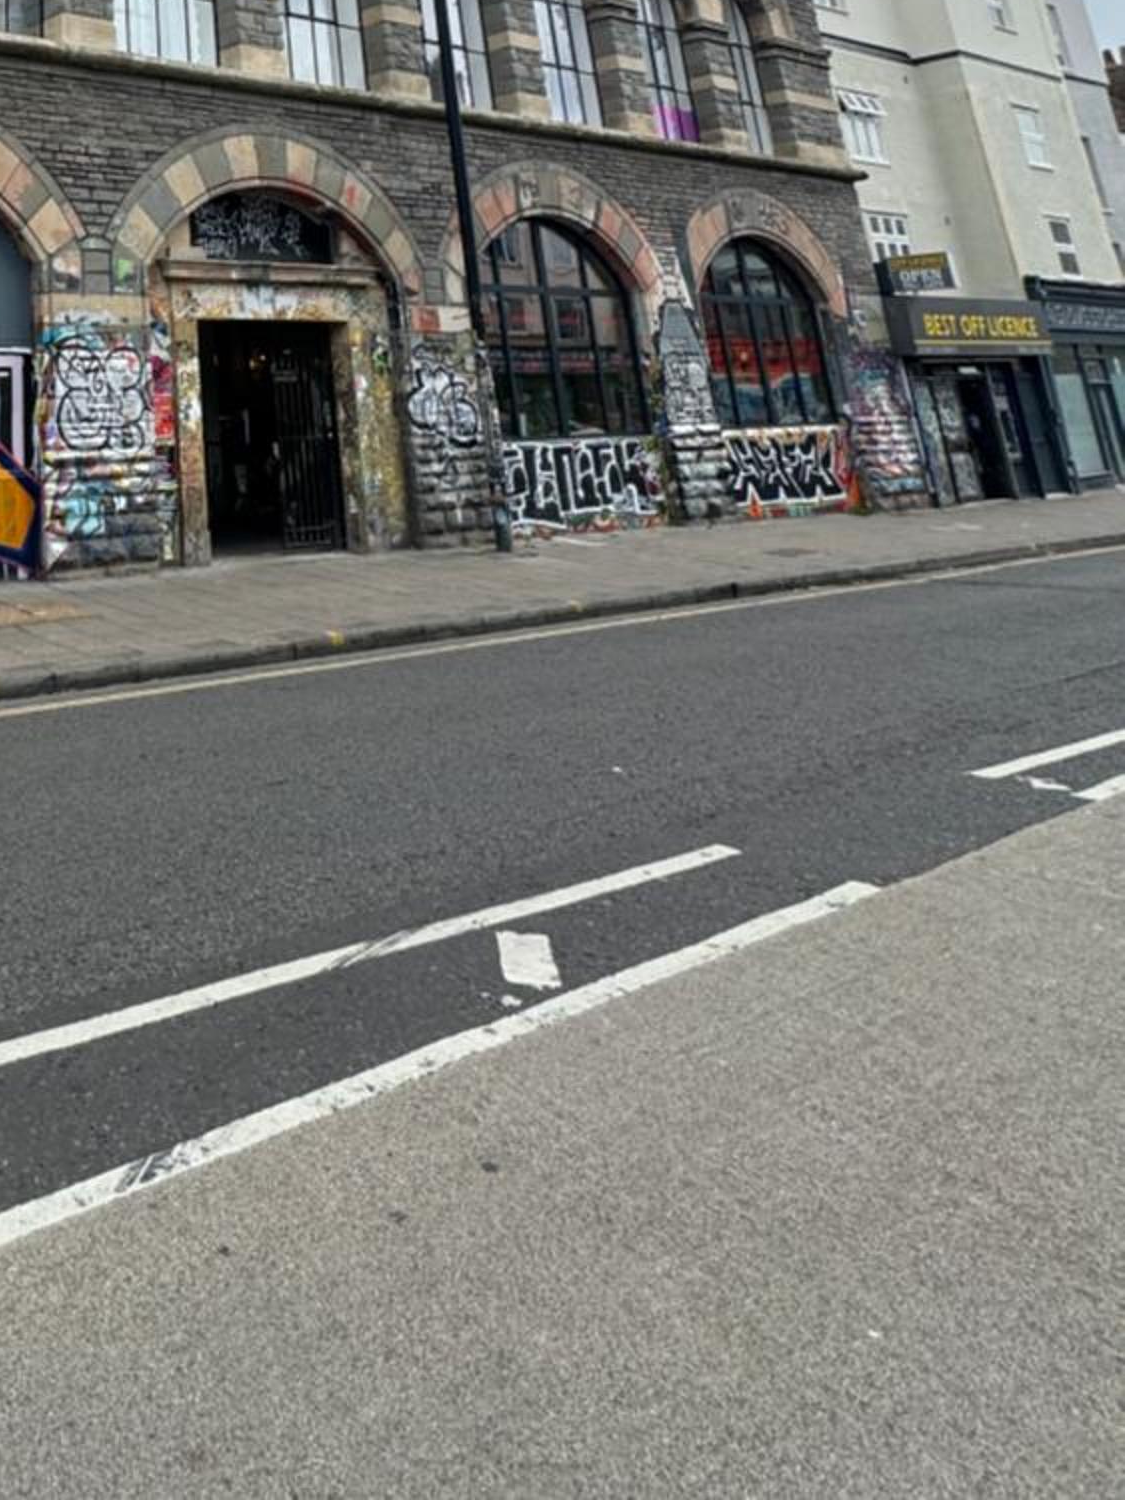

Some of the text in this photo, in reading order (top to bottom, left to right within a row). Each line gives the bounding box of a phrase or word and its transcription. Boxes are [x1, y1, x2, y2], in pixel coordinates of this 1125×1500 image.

[922, 313, 956, 338] BEST
[960, 313, 985, 338] OFF
[986, 314, 1039, 339] LICENCE
